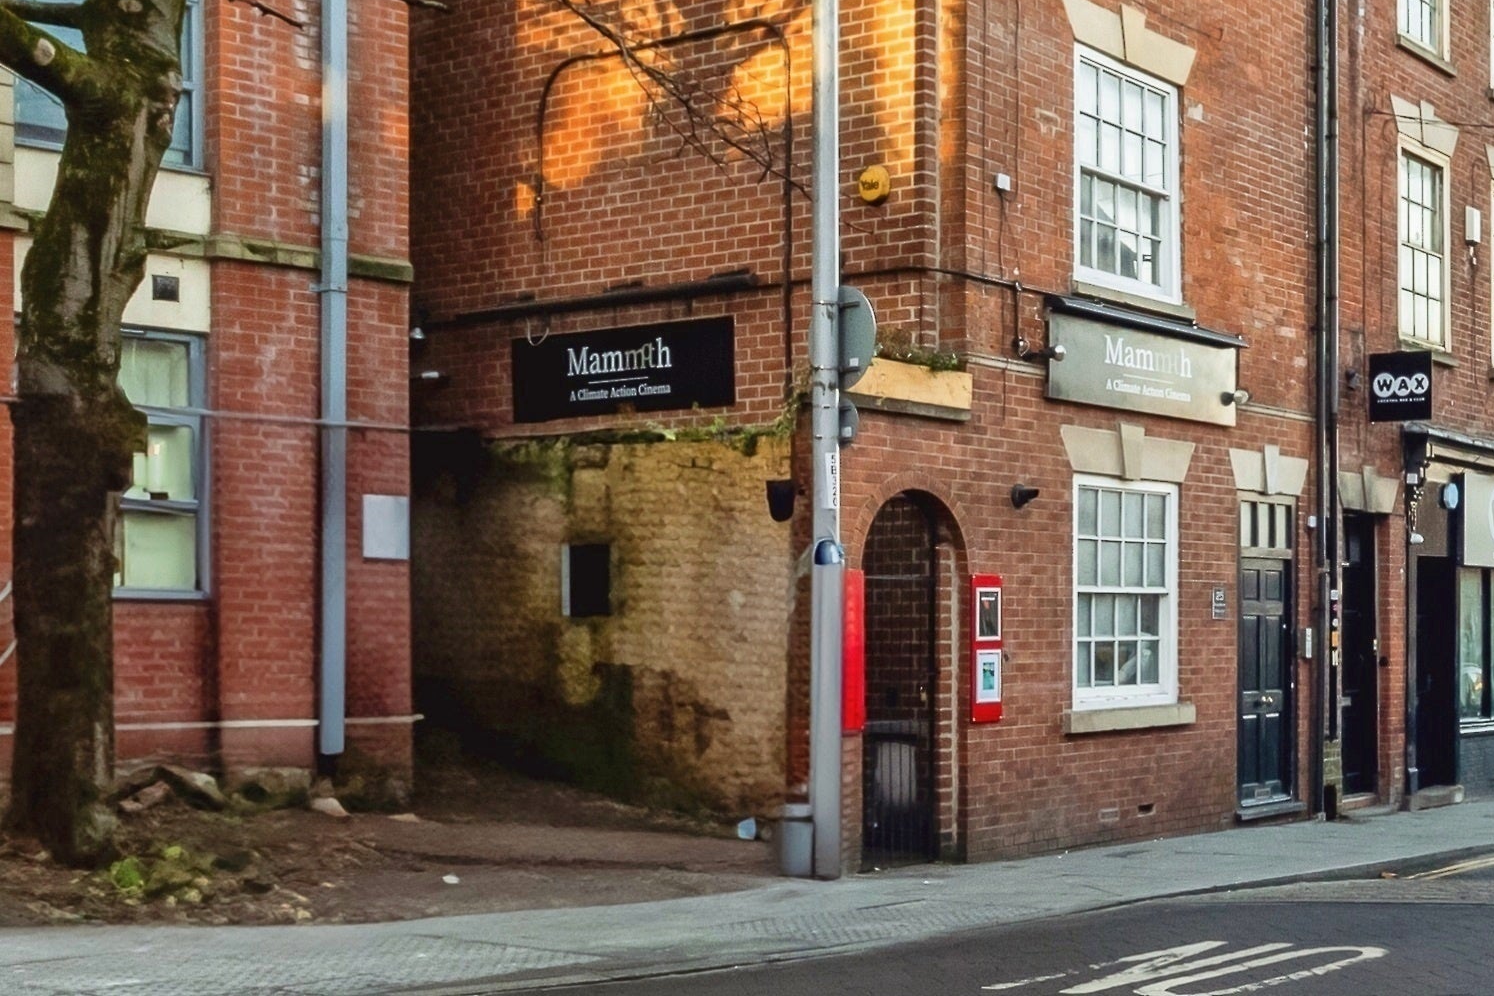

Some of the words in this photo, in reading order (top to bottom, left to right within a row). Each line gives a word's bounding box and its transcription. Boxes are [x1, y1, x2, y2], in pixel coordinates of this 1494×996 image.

[1104, 334, 1192, 378] Mammth
[569, 390, 576, 402] A
[577, 388, 609, 401] Climate
[610, 384, 637, 398] Action
[638, 382, 671, 396] Cinema
[1106, 378, 1113, 390] A
[1376, 375, 1426, 394] WAX
